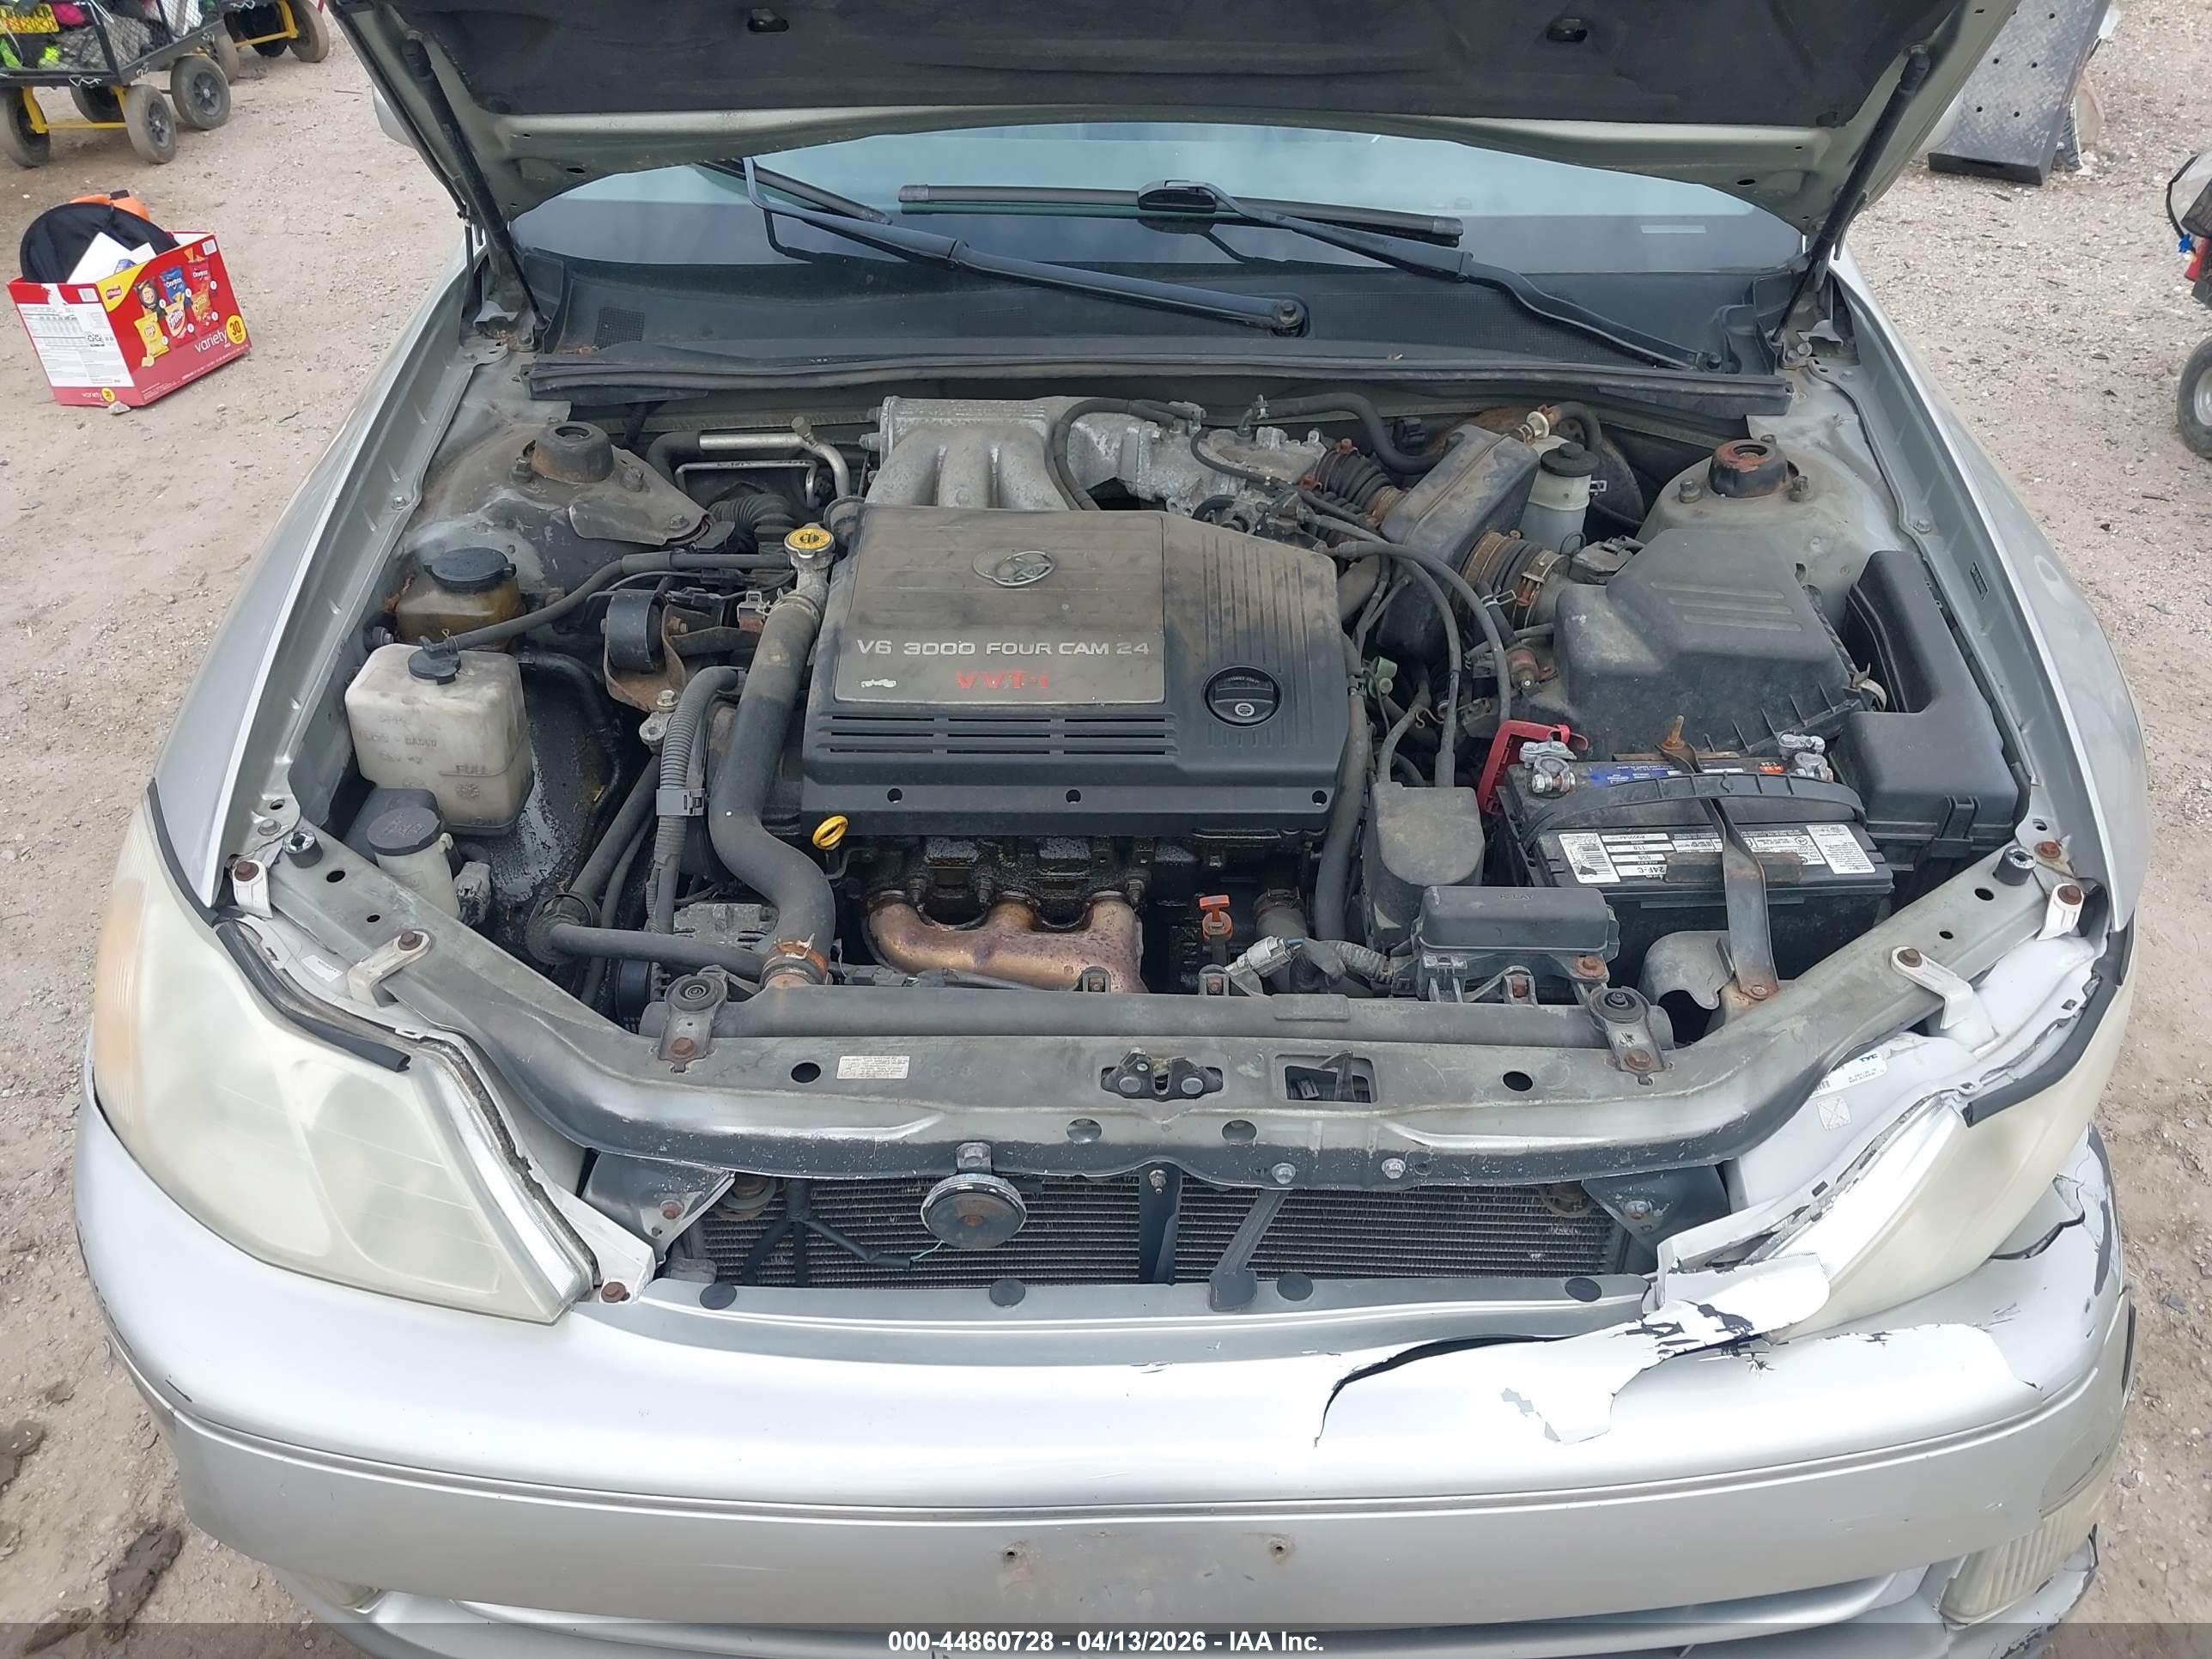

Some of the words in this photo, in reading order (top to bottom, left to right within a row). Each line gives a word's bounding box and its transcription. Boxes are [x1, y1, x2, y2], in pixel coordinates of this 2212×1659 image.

[229, 320, 242, 336] 30
[194, 330, 228, 352] variety
[857, 640, 892, 654] V6
[903, 642, 976, 655] 3000
[987, 642, 1054, 655] FOUR
[1059, 642, 1109, 655] CAM
[1116, 642, 1151, 655] 24
